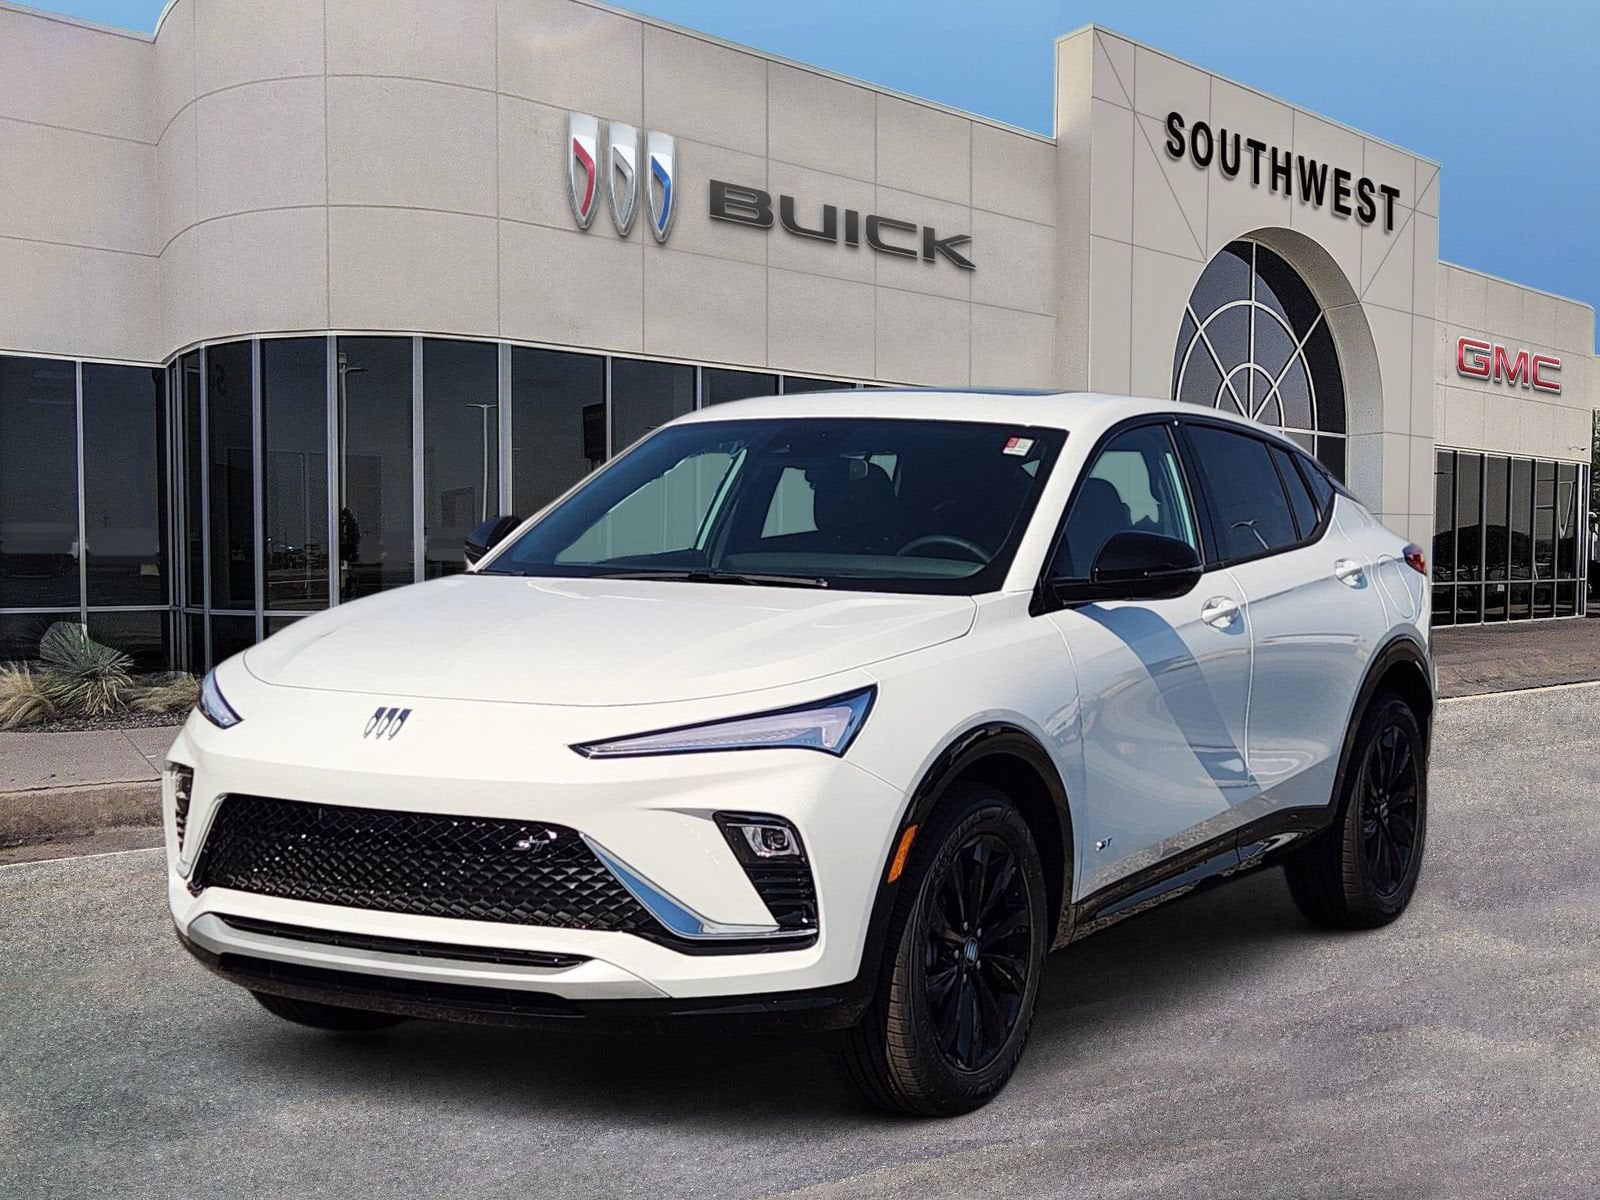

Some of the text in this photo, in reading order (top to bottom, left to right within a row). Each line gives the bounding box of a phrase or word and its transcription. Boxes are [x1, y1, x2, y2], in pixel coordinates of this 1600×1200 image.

[1165, 111, 1401, 232] SOUTHWEST
[709, 179, 977, 270] BUICK
[1457, 336, 1561, 394] GMC
